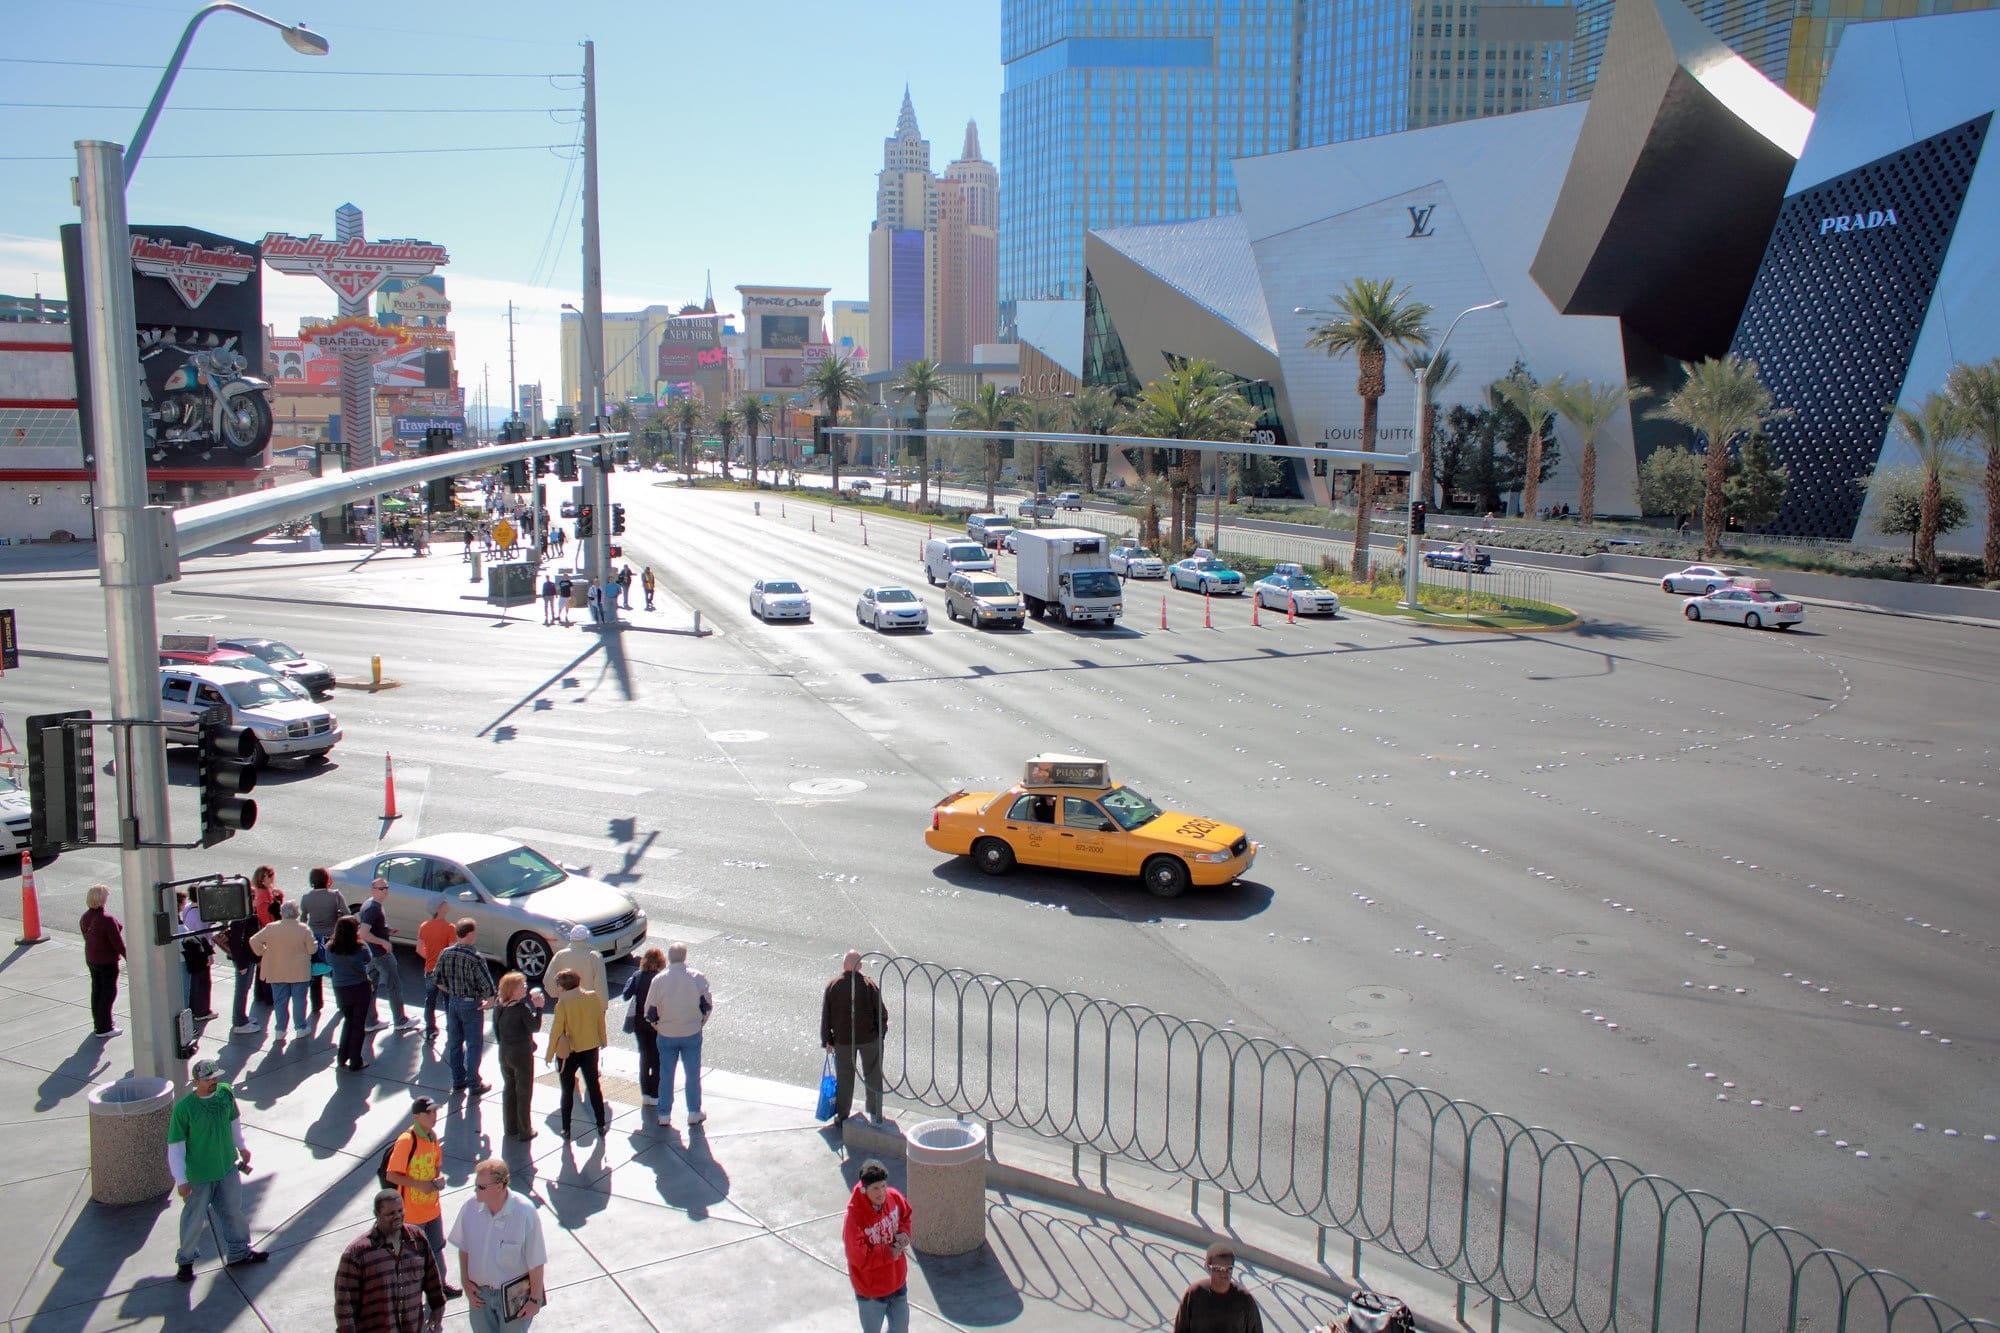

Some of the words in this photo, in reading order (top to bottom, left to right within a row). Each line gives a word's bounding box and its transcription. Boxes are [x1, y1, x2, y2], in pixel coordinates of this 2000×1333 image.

[1819, 209, 1898, 236] PRADA
[164, 266, 184, 274] LAS
[189, 269, 223, 278] VEGAS
[344, 263, 394, 271] VEGAS
[394, 300, 416, 309] POLO
[419, 300, 450, 309] TOWERS
[671, 319, 689, 328] NEW
[690, 319, 713, 328] YORK
[670, 329, 689, 340] NEW
[690, 329, 713, 340] YORK
[806, 348, 828, 358] CVS
[1018, 371, 1063, 396] GUCCI
[397, 418, 465, 434] Travelodge
[1325, 428, 1364, 440] LOUIS
